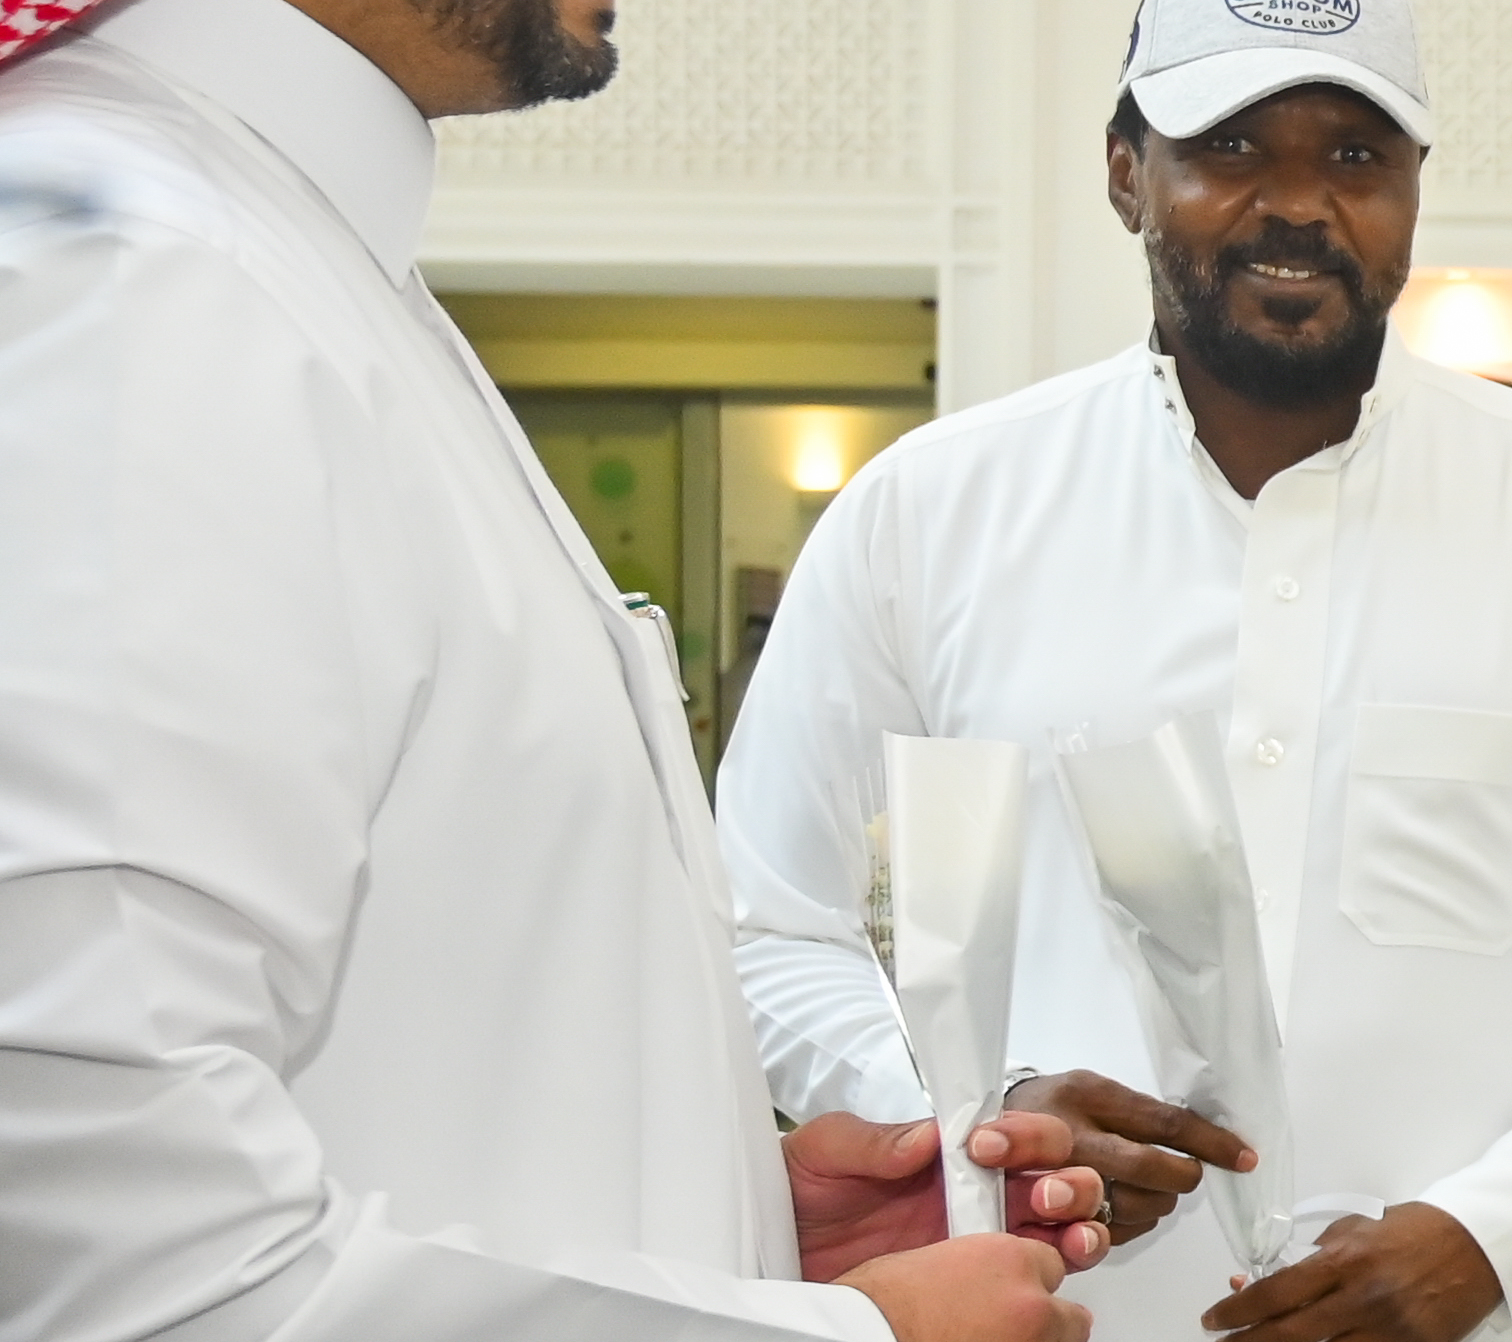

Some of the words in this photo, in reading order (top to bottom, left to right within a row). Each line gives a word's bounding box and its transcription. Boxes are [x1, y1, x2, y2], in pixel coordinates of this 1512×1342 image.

[1268, 0, 1322, 14] SHOP
[1253, 10, 1294, 26] POLO
[1301, 18, 1337, 29] CLUB
